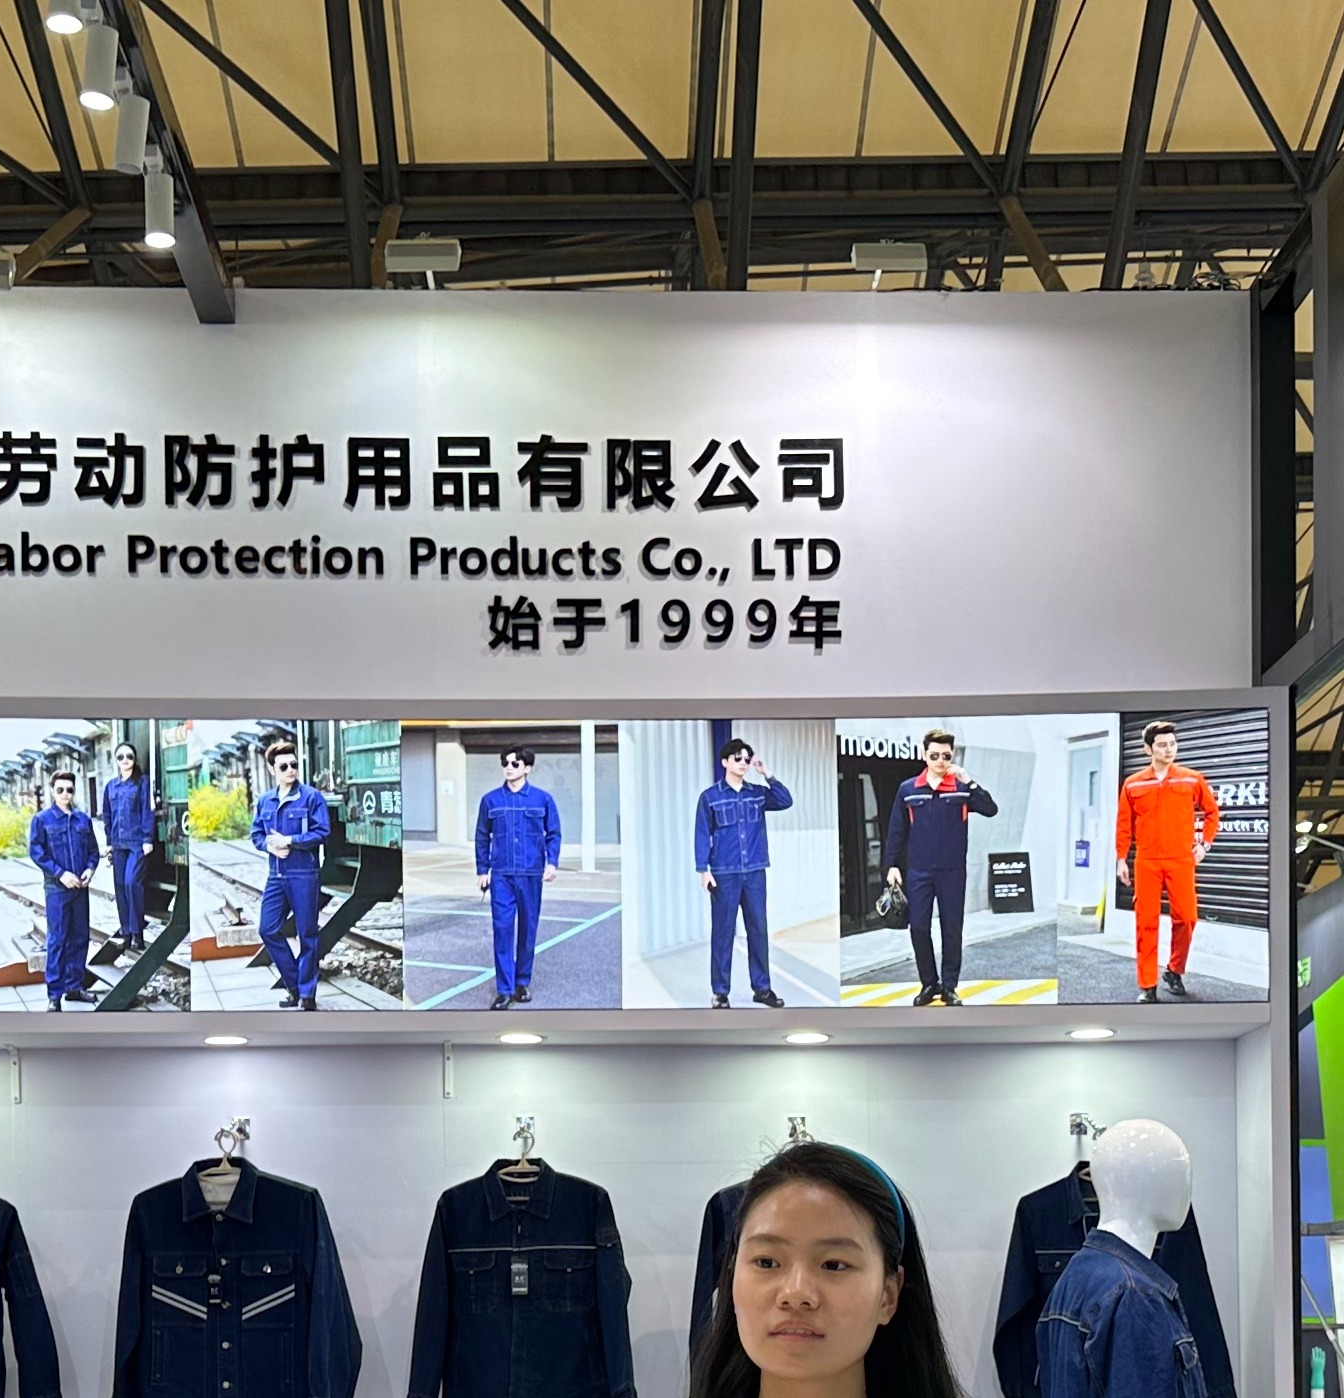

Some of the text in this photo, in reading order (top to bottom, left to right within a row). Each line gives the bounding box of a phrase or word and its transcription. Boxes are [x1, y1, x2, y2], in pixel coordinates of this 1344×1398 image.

[128, 534, 385, 576] Protection
[410, 536, 622, 578] Products
[641, 538, 731, 583] Co.,
[752, 538, 842, 579] LTD
[487, 595, 843, 652] 始于1999年
